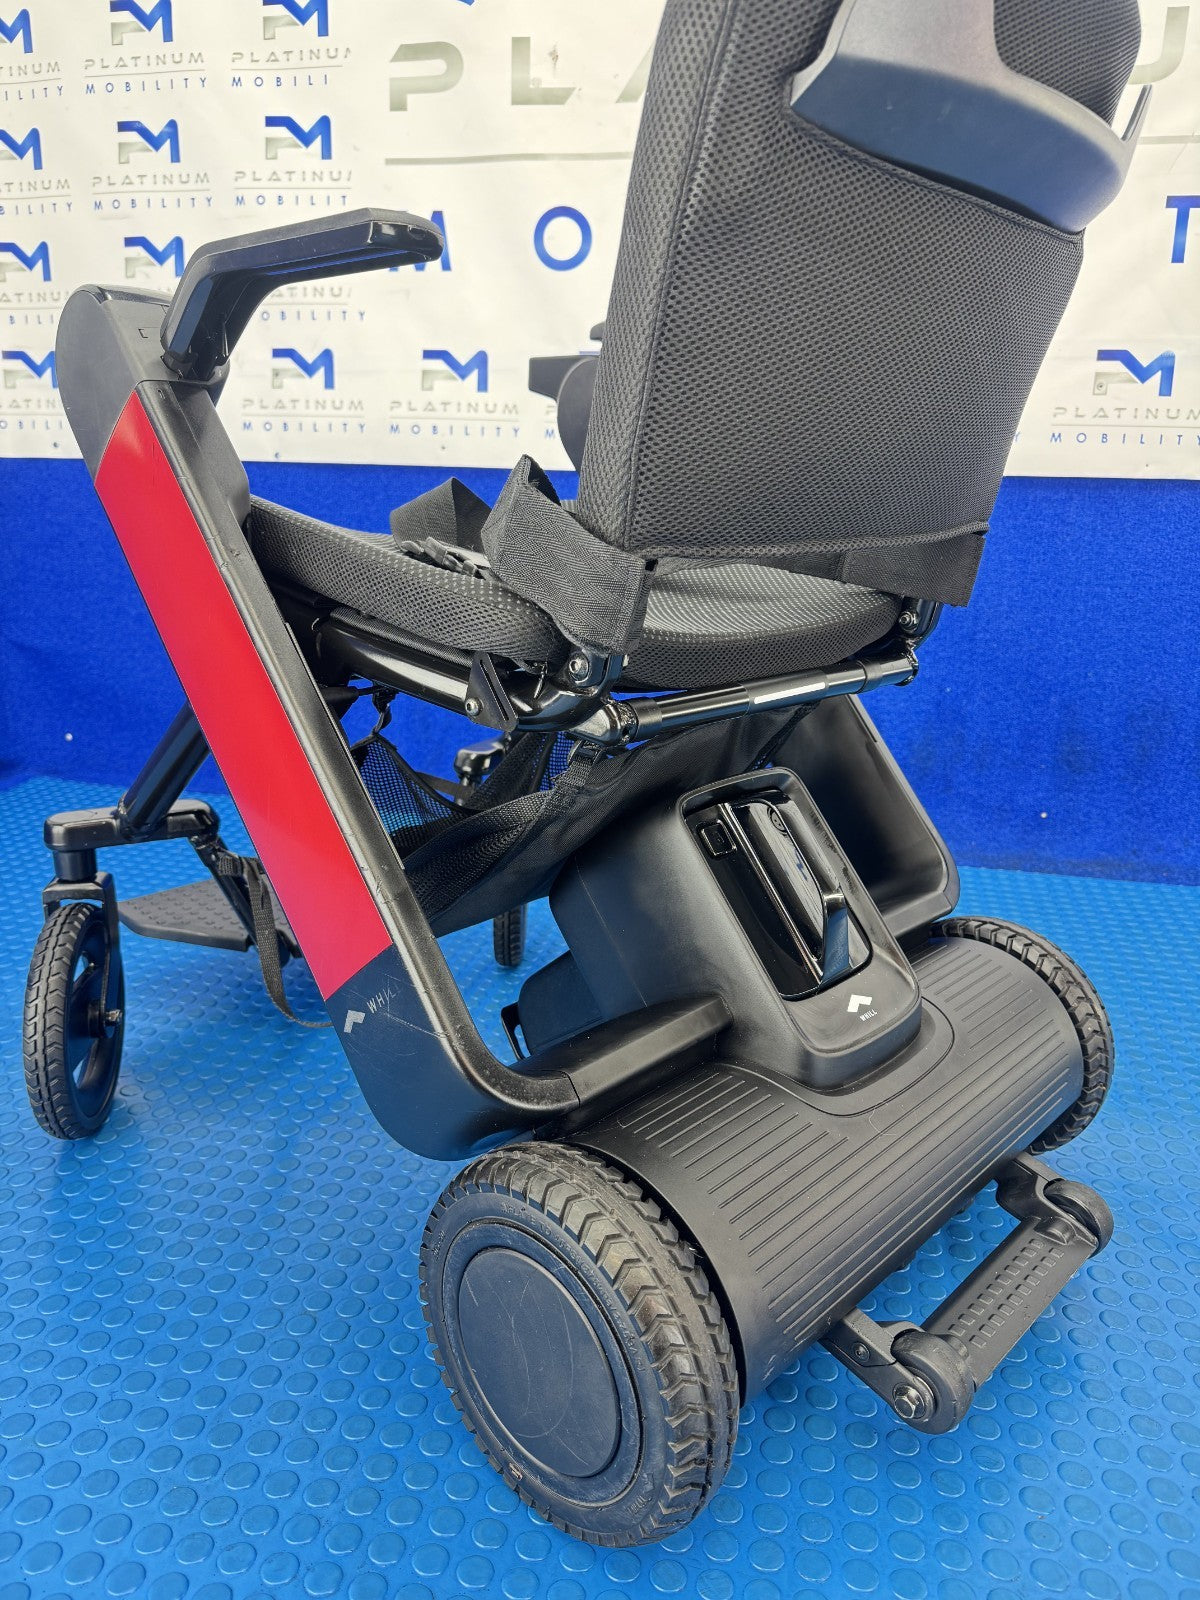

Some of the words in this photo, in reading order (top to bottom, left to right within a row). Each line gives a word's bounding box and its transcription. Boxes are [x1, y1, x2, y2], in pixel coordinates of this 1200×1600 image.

[84, 52, 205, 70] PLATINUM
[85, 78, 207, 95] MOBILITY
[92, 172, 210, 187] PLATINUM
[234, 170, 352, 183] PLATINU
[94, 197, 213, 211] MOBILITY
[242, 398, 364, 412] PLATINUM
[389, 400, 519, 415] PLATINUM
[1052, 406, 1200, 421] PLATINUM
[242, 421, 366, 434] MOBILITY
[389, 424, 521, 438] MOBILITY
[1050, 432, 1200, 446] MOBILITY
[859, 1009, 878, 1022] WHILL
